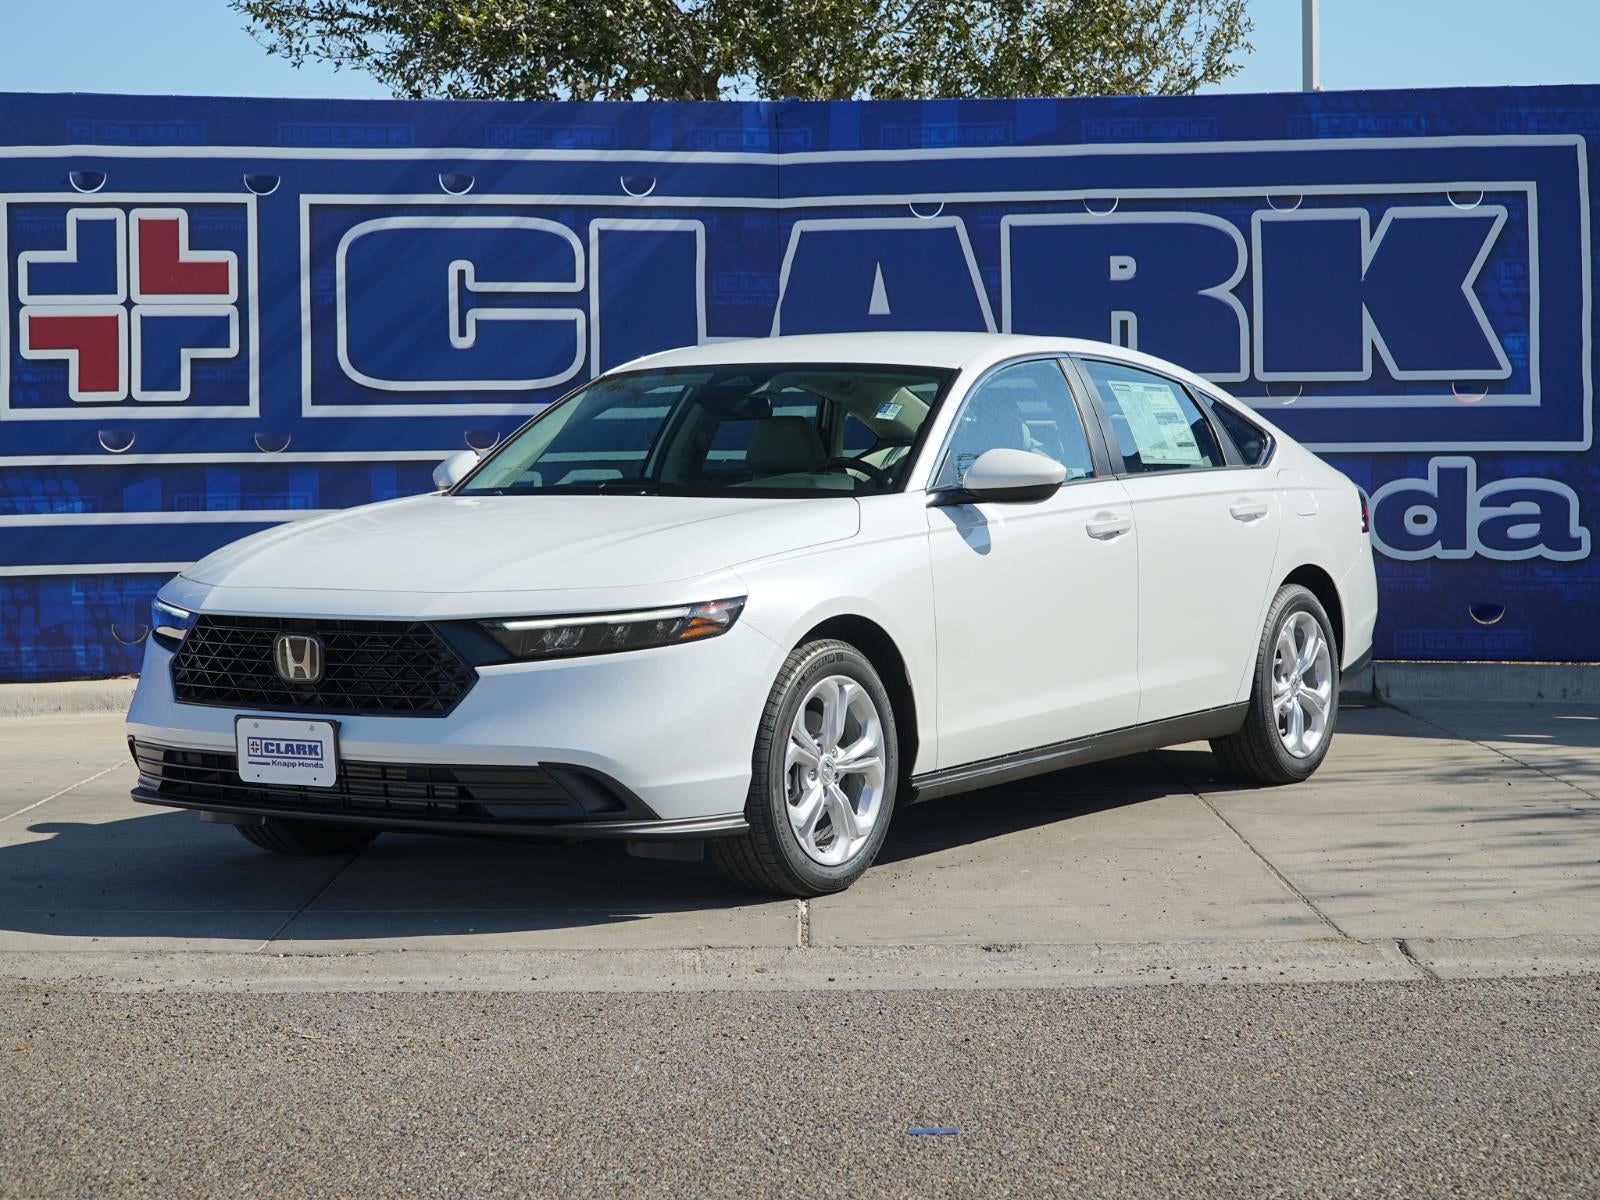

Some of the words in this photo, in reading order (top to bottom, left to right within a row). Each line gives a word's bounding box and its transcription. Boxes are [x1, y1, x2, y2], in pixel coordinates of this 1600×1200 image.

[336, 204, 1512, 394] CLARK
[1357, 456, 1591, 561] da
[264, 742, 319, 756] CLARK
[271, 760, 297, 768] Knapp
[298, 761, 324, 769] Honda
